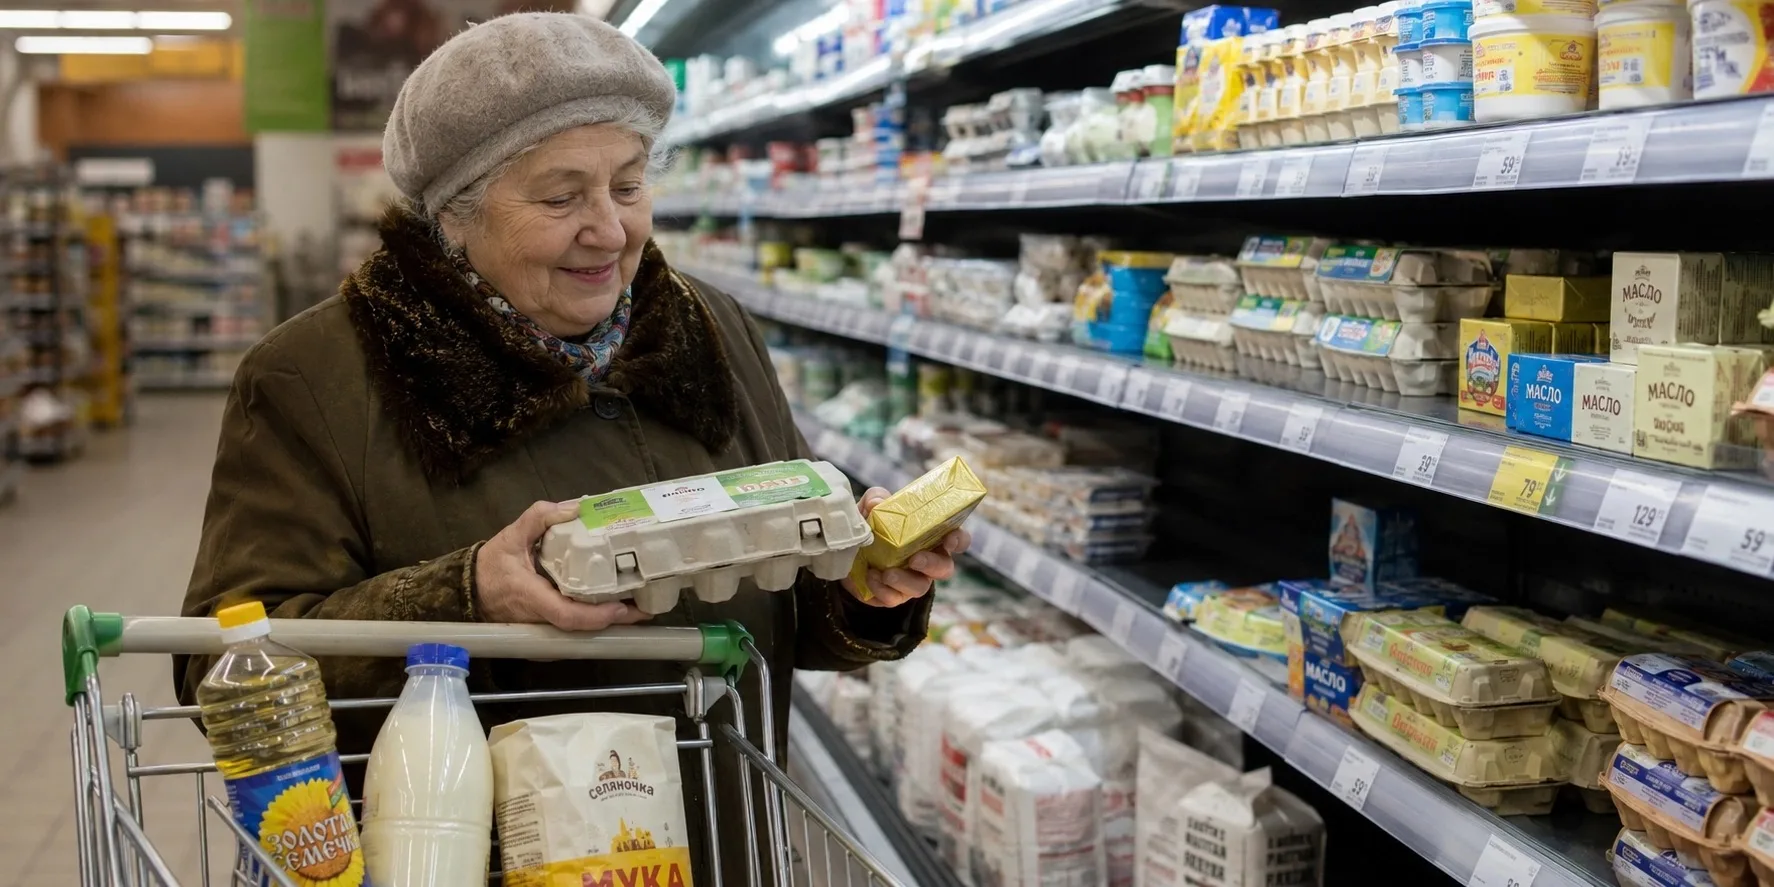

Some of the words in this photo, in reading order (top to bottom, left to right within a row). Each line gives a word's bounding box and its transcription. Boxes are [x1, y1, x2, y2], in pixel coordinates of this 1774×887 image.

[1622, 283, 1662, 304] МАСЛО
[1525, 383, 1562, 405] МАСЛО
[1648, 381, 1695, 408] МАСЛО
[1581, 395, 1621, 416] МАСЛО
[1519, 478, 1537, 499] 79
[1632, 504, 1657, 527] 129
[1740, 528, 1766, 553] 59
[1305, 660, 1346, 694] МАСЛО
